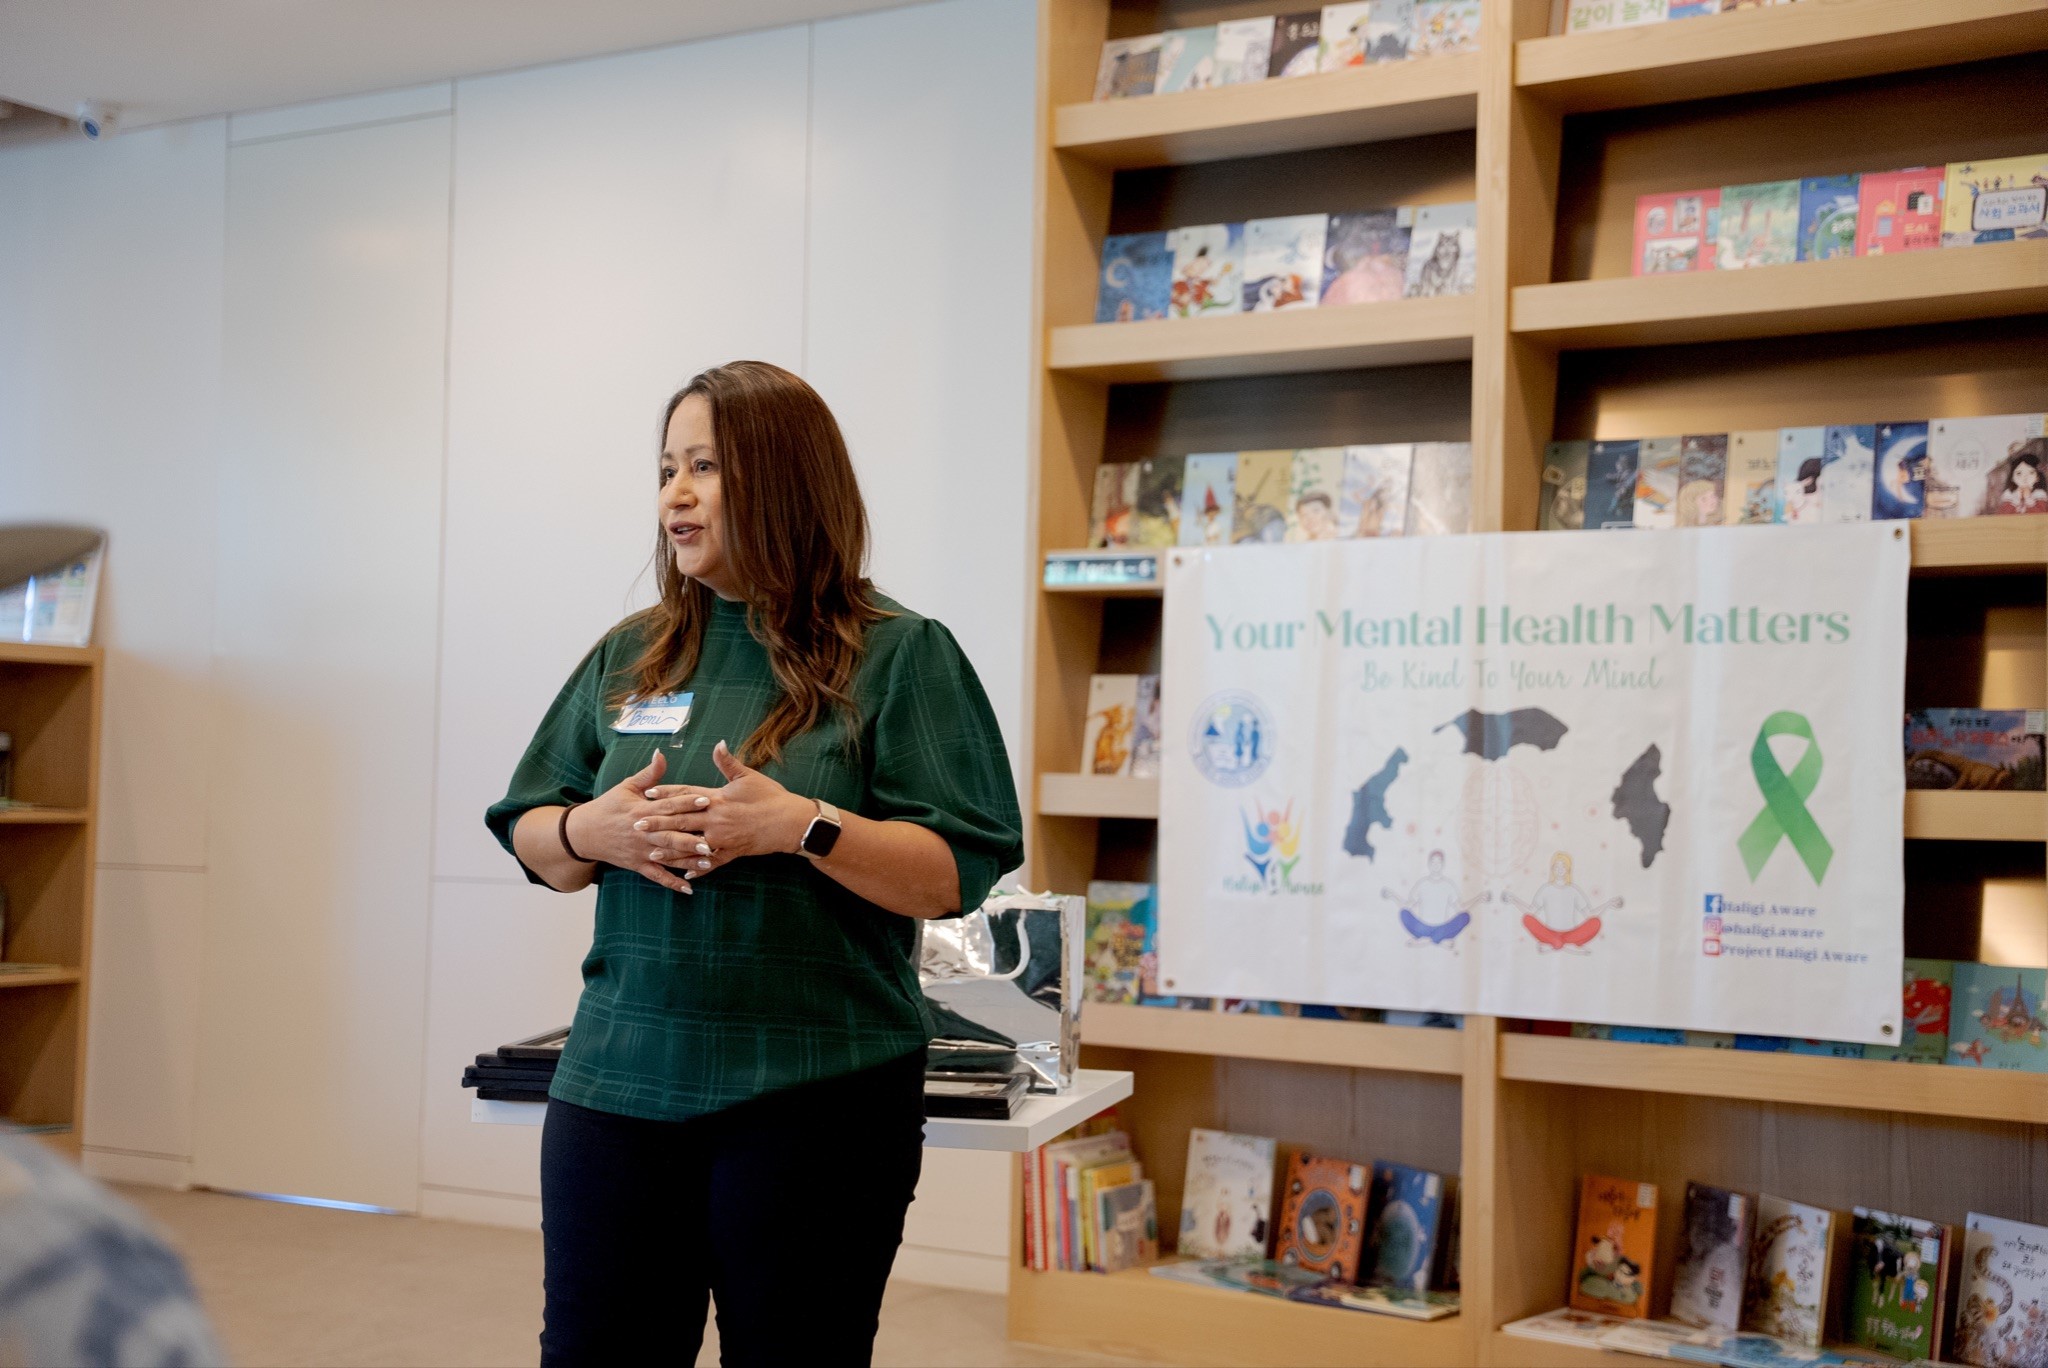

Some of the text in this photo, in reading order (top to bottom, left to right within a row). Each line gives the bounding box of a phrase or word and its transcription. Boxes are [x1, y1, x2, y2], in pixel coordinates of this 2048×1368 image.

[1204, 602, 1851, 651] Your Mental Health Matters
[1360, 654, 1664, 693] Be Kind To Your Mind
[1769, 904, 1817, 917] Aware
[1720, 944, 1869, 964] Project Haligi Aware
